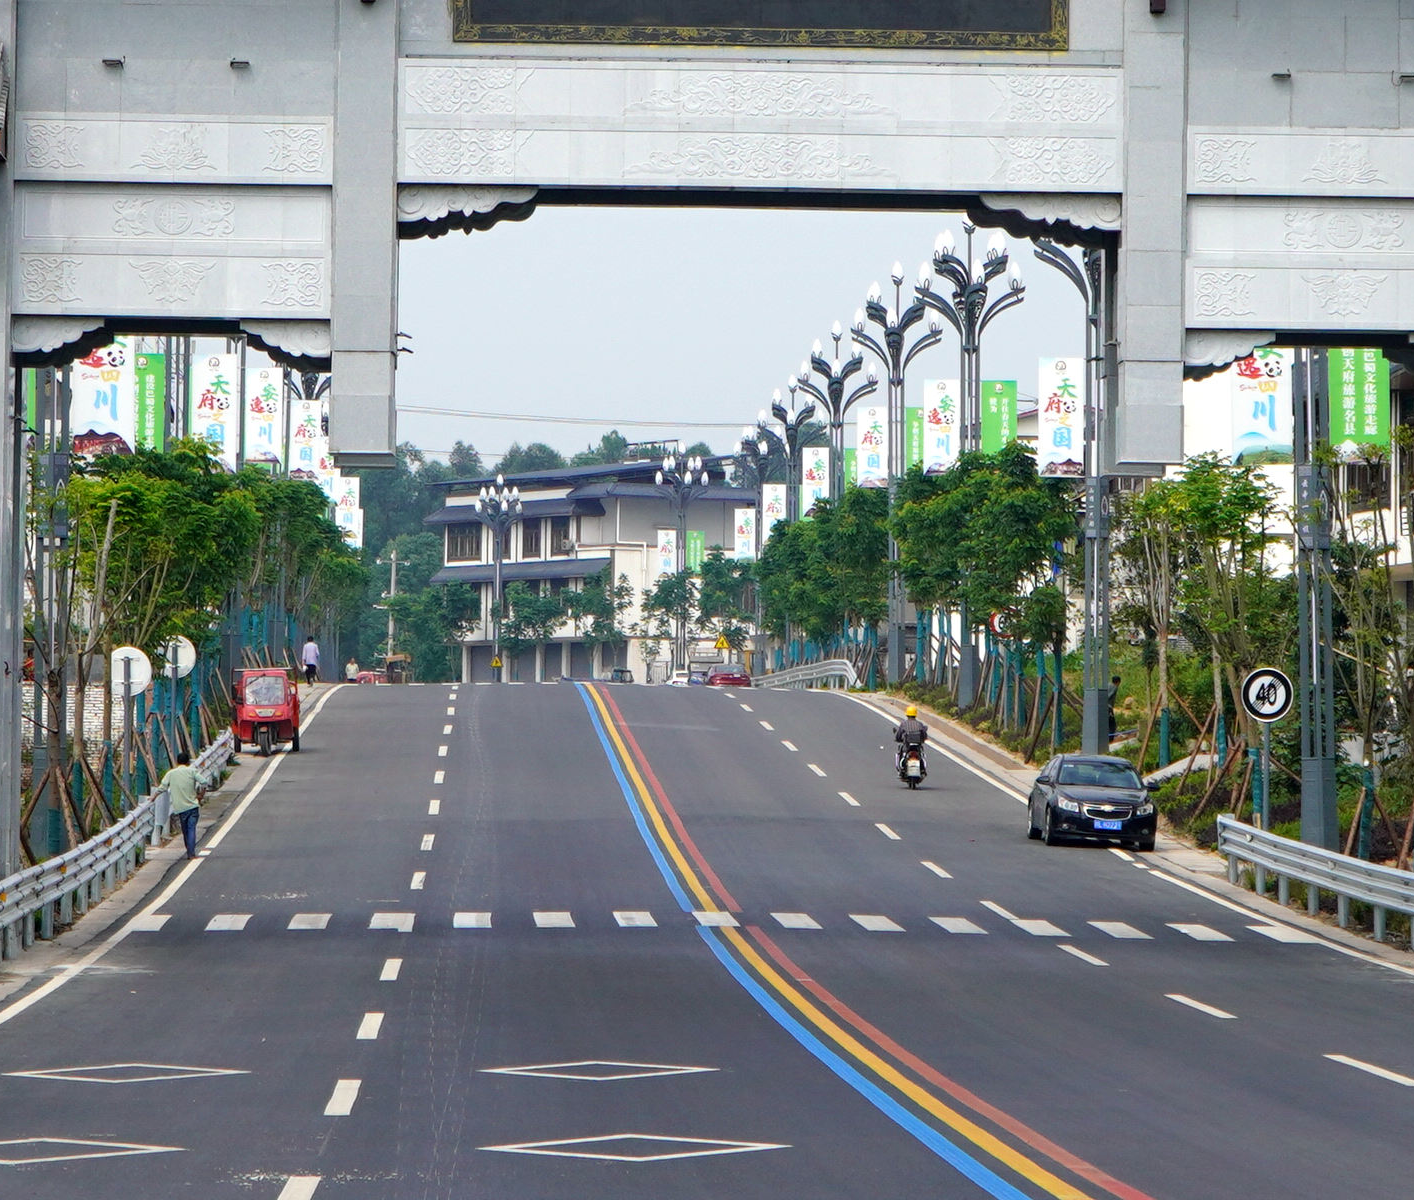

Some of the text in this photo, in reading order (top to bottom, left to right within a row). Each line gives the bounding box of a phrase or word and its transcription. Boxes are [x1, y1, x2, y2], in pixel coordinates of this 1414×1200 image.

[1044, 378, 1078, 450] 天府之国
[1363, 349, 1378, 435] 巴蜀文化旅游走廊
[1255, 683, 1278, 706] 40
